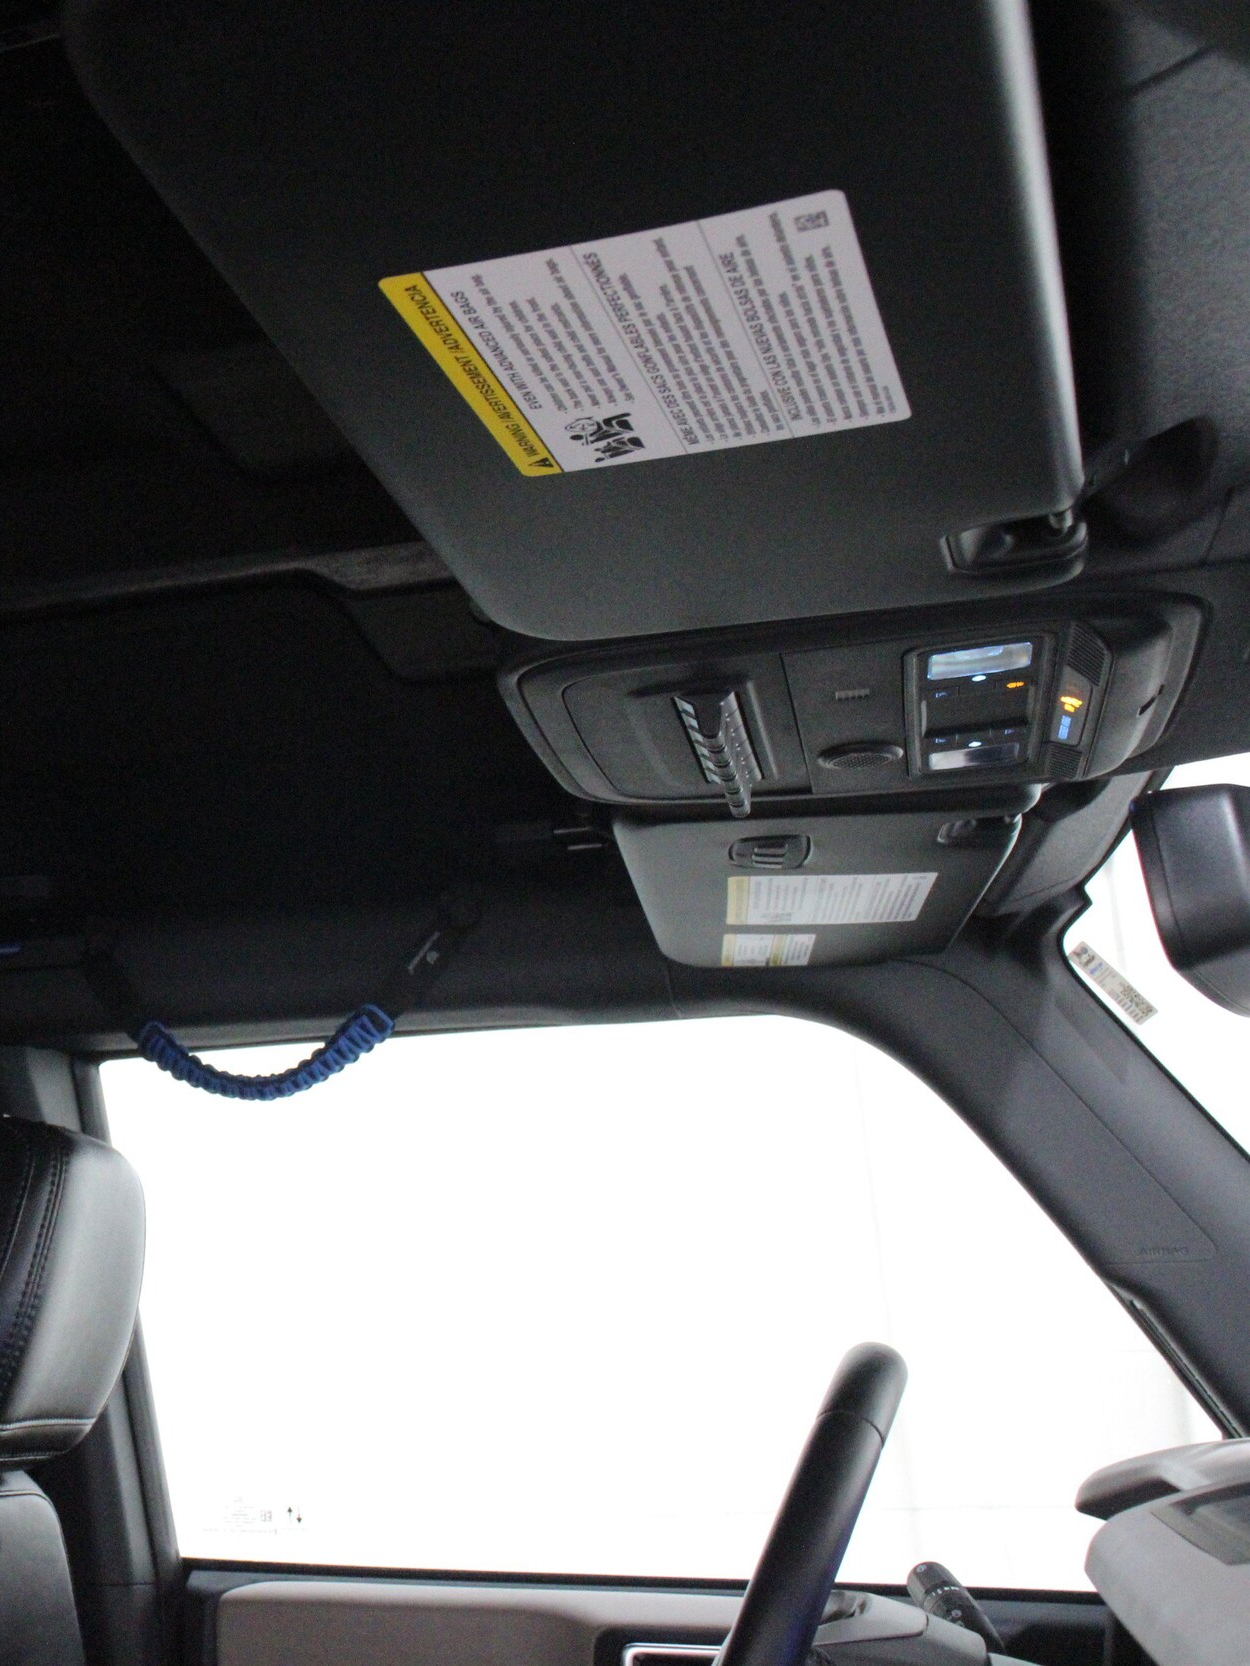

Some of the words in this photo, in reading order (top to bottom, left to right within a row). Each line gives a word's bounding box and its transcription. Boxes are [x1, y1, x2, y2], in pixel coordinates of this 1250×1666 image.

[727, 273, 746, 288] DE
[448, 289, 478, 316] BAGS
[466, 314, 488, 331] AIR
[476, 329, 517, 373] ADVANCED
[761, 353, 781, 370] LAS
[505, 371, 530, 391] WITH
[649, 373, 672, 394] SACS
[518, 390, 543, 410] EVEN
[660, 392, 681, 409] DES
[503, 422, 541, 458] WARNING
